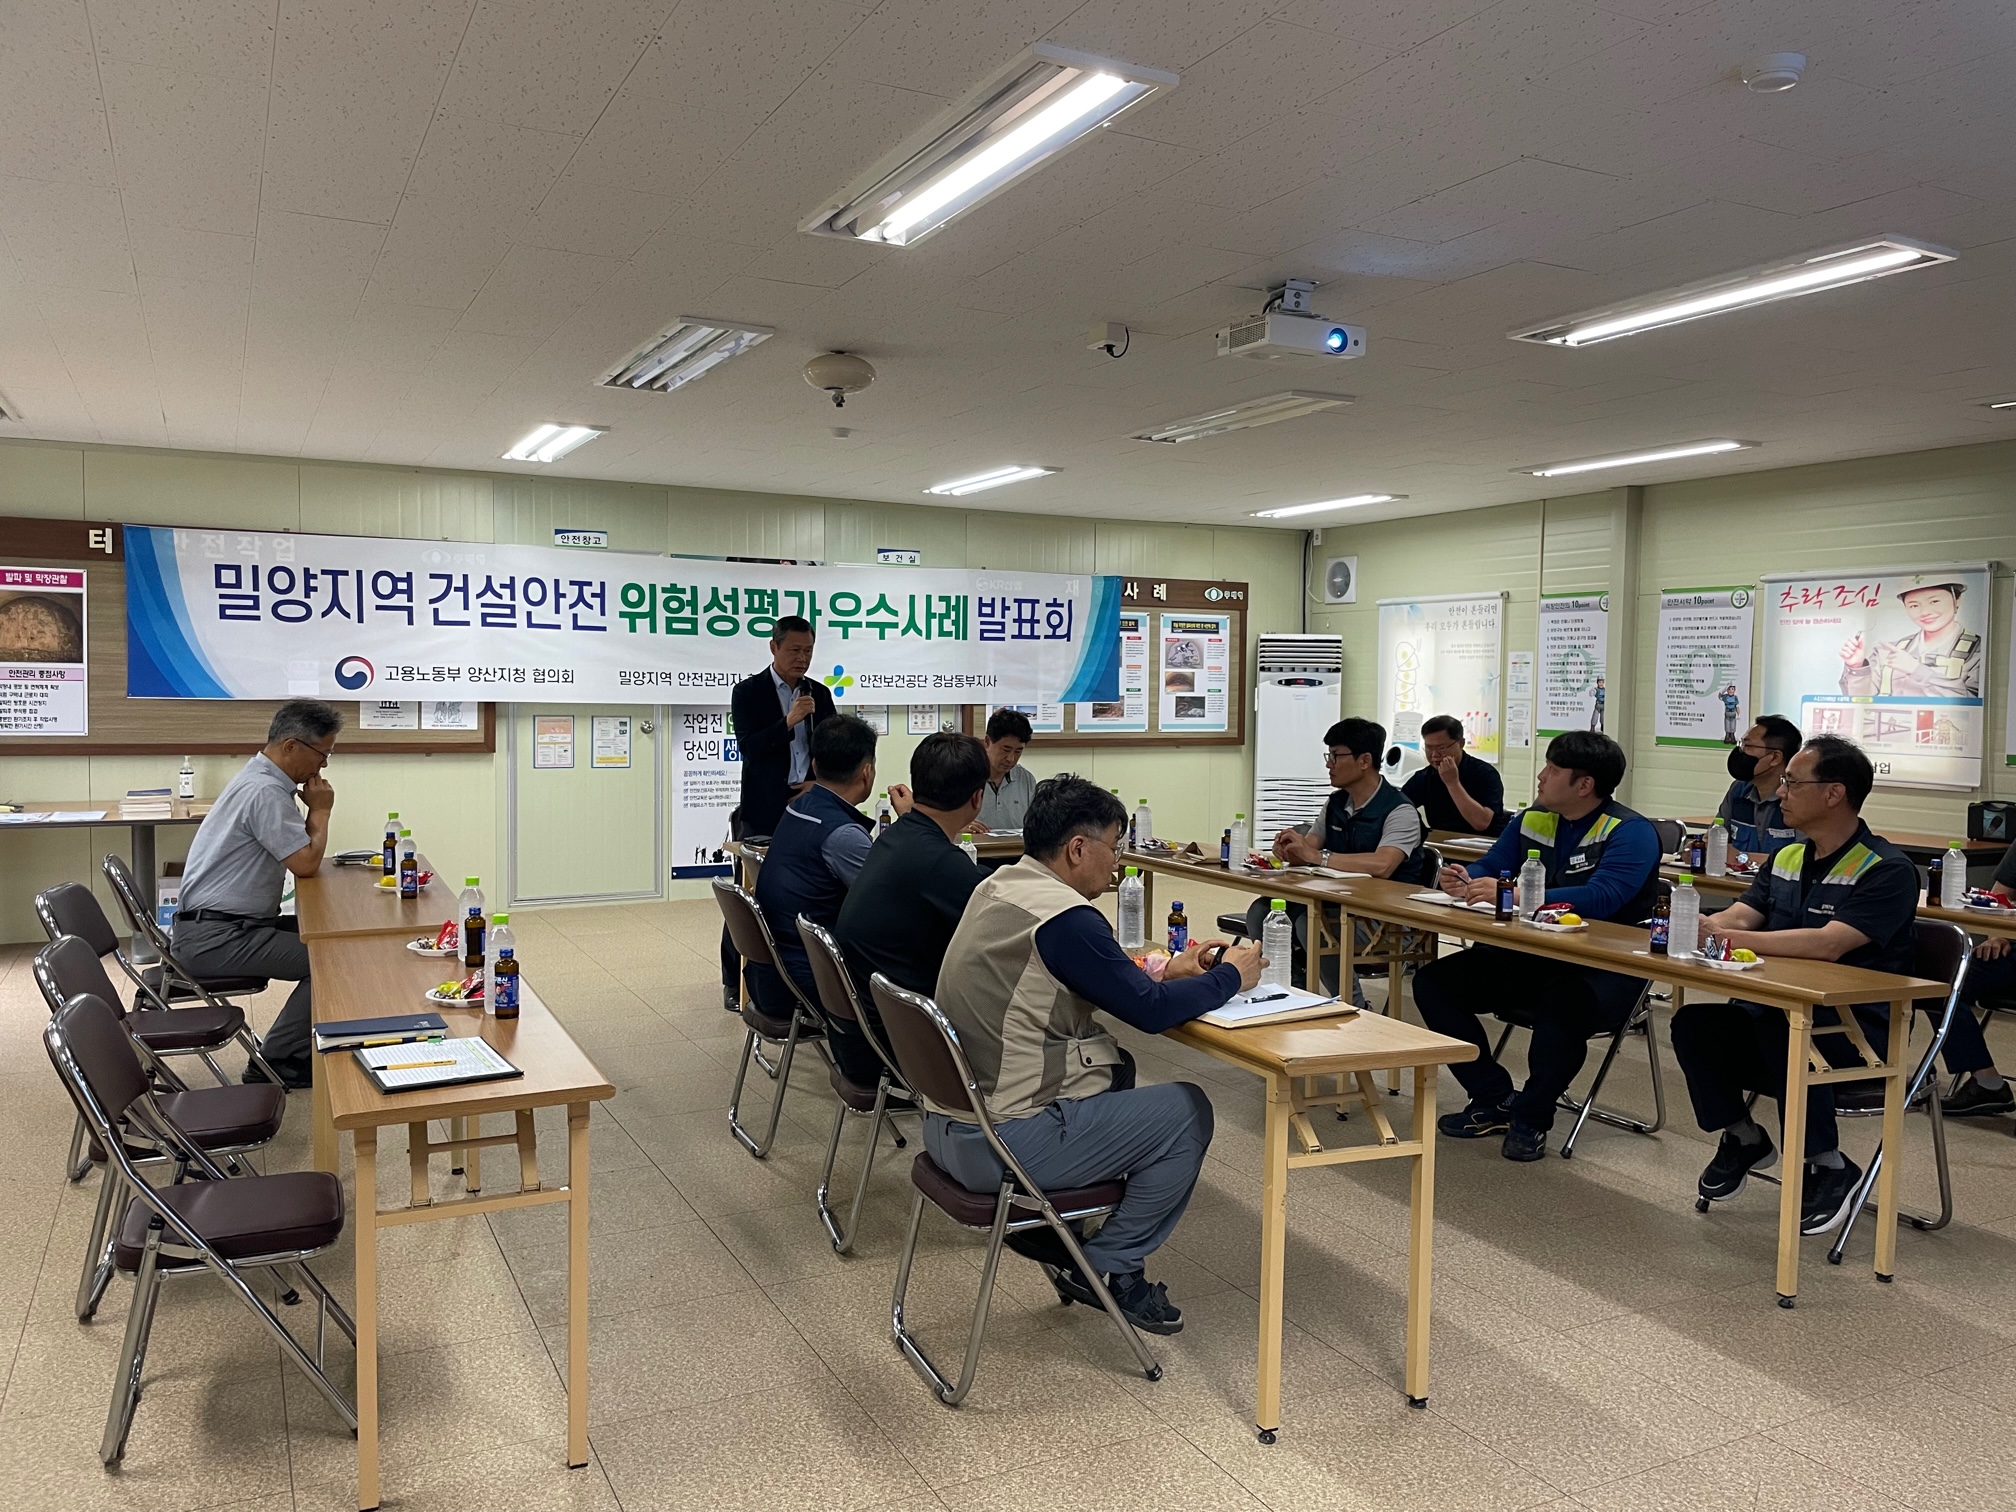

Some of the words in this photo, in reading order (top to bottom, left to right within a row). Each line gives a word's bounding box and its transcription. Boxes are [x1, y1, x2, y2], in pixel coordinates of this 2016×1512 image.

[88, 527, 113, 554] 터
[560, 534, 602, 545] 안전창고
[882, 554, 917, 564] 보건실
[214, 563, 414, 626] 밀양지역
[428, 572, 608, 632] 건설안전
[618, 582, 822, 638] 위험성평가
[828, 591, 969, 641] 우수사례
[977, 596, 1073, 642] 발표회
[1779, 585, 1831, 613] 추락
[1833, 583, 1881, 608] 조심
[1448, 605, 1468, 616] 안전이
[1470, 603, 1498, 615] 흔들리면
[1424, 621, 1438, 632] 우리
[1440, 620, 1459, 631] 모두가
[8, 669, 36, 679] 안전관리
[385, 665, 462, 682] 고용노동부
[467, 666, 527, 683] 양산지청
[532, 668, 575, 684] 협의회
[619, 670, 672, 686] 밀양지역
[677, 672, 743, 688] 안전관리자
[859, 674, 929, 689] 안전보건공단
[932, 674, 998, 688] 경남동부지사
[683, 713, 709, 734] 작업
[710, 713, 723, 734] 전
[683, 740, 720, 761] 당신의
